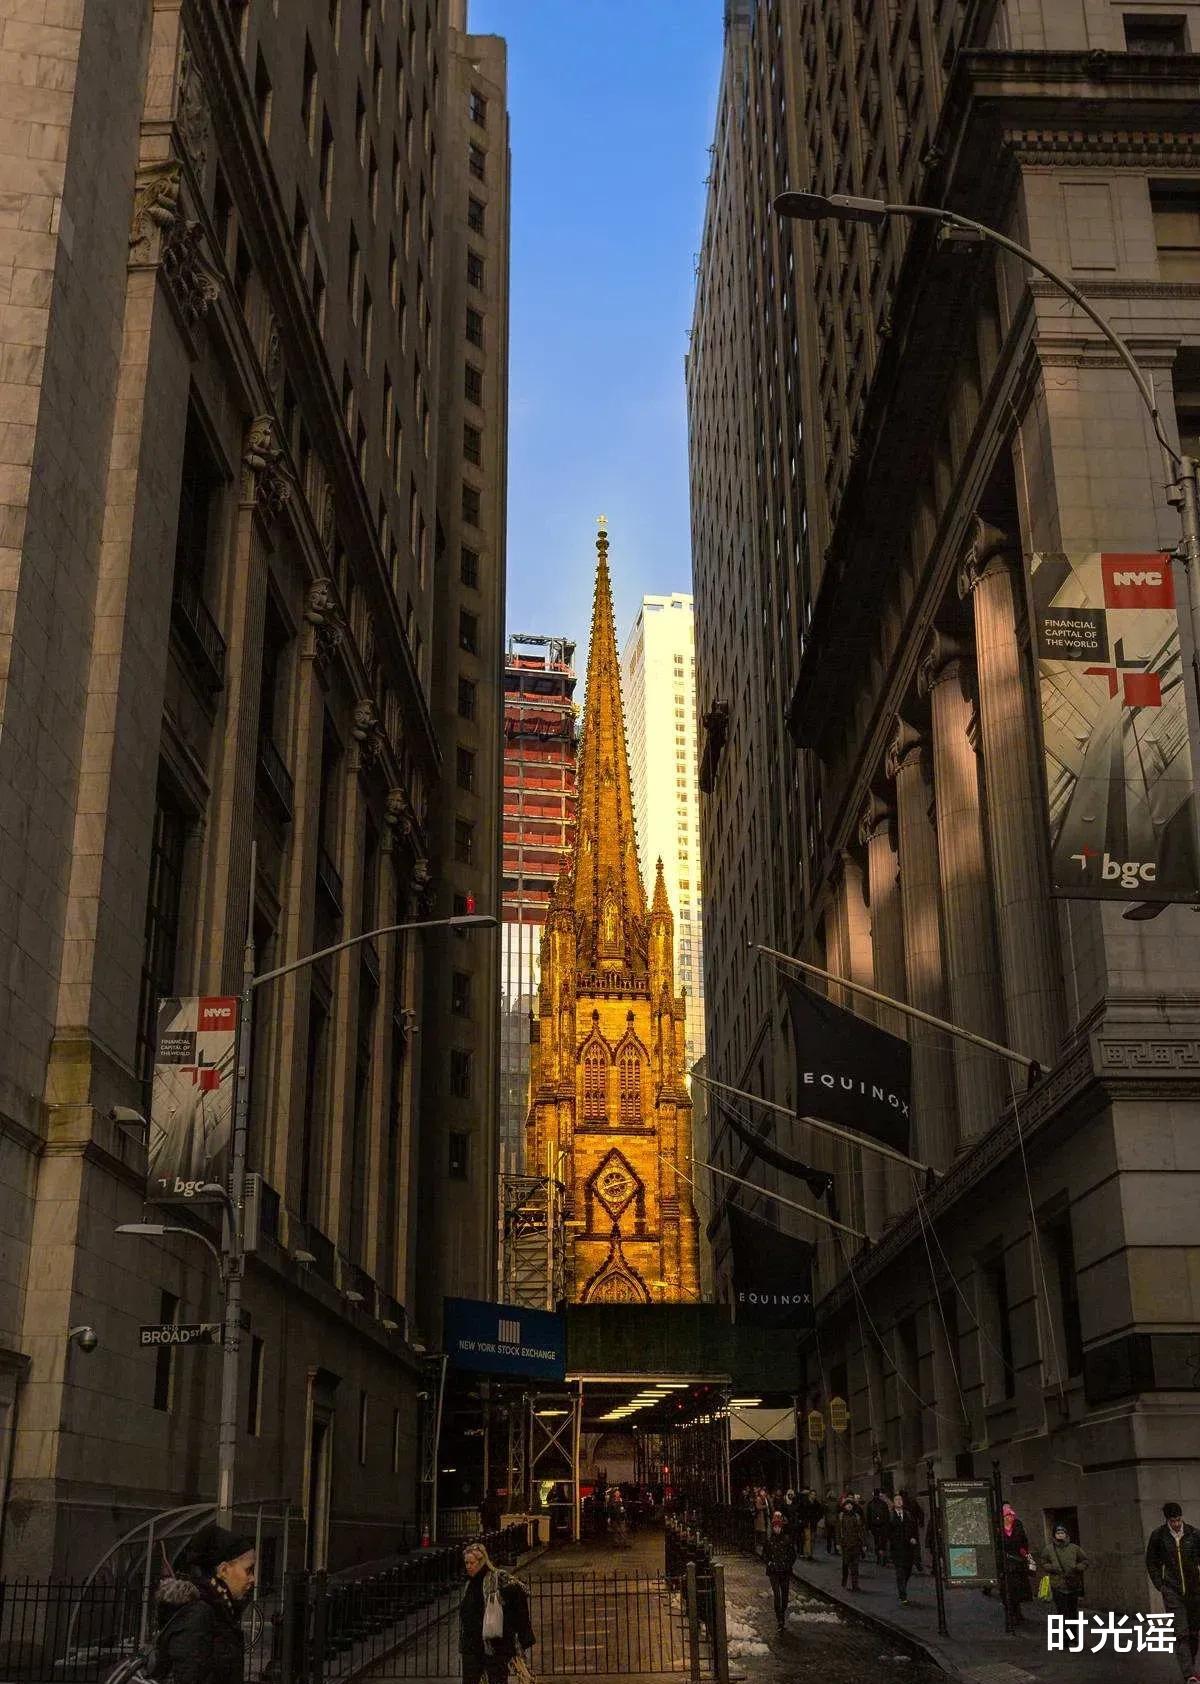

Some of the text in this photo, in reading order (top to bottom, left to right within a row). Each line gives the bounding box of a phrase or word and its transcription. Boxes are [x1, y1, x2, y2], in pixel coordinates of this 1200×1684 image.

[1113, 571, 1163, 586] NYC
[1044, 619, 1096, 629] FINANCIAL
[1044, 629, 1097, 639] CAPITAL OF
[1046, 639, 1098, 648] THE WORLD
[1101, 852, 1156, 889] bgc
[203, 1007, 231, 1018] NYC
[803, 1072, 909, 1119] EQUINOX
[174, 1176, 204, 1197] bgc
[739, 1292, 810, 1305] EQUINOX
[141, 1330, 190, 1344] BROAD
[459, 1340, 556, 1360] NEW YORK STOCK EXCHANGE
